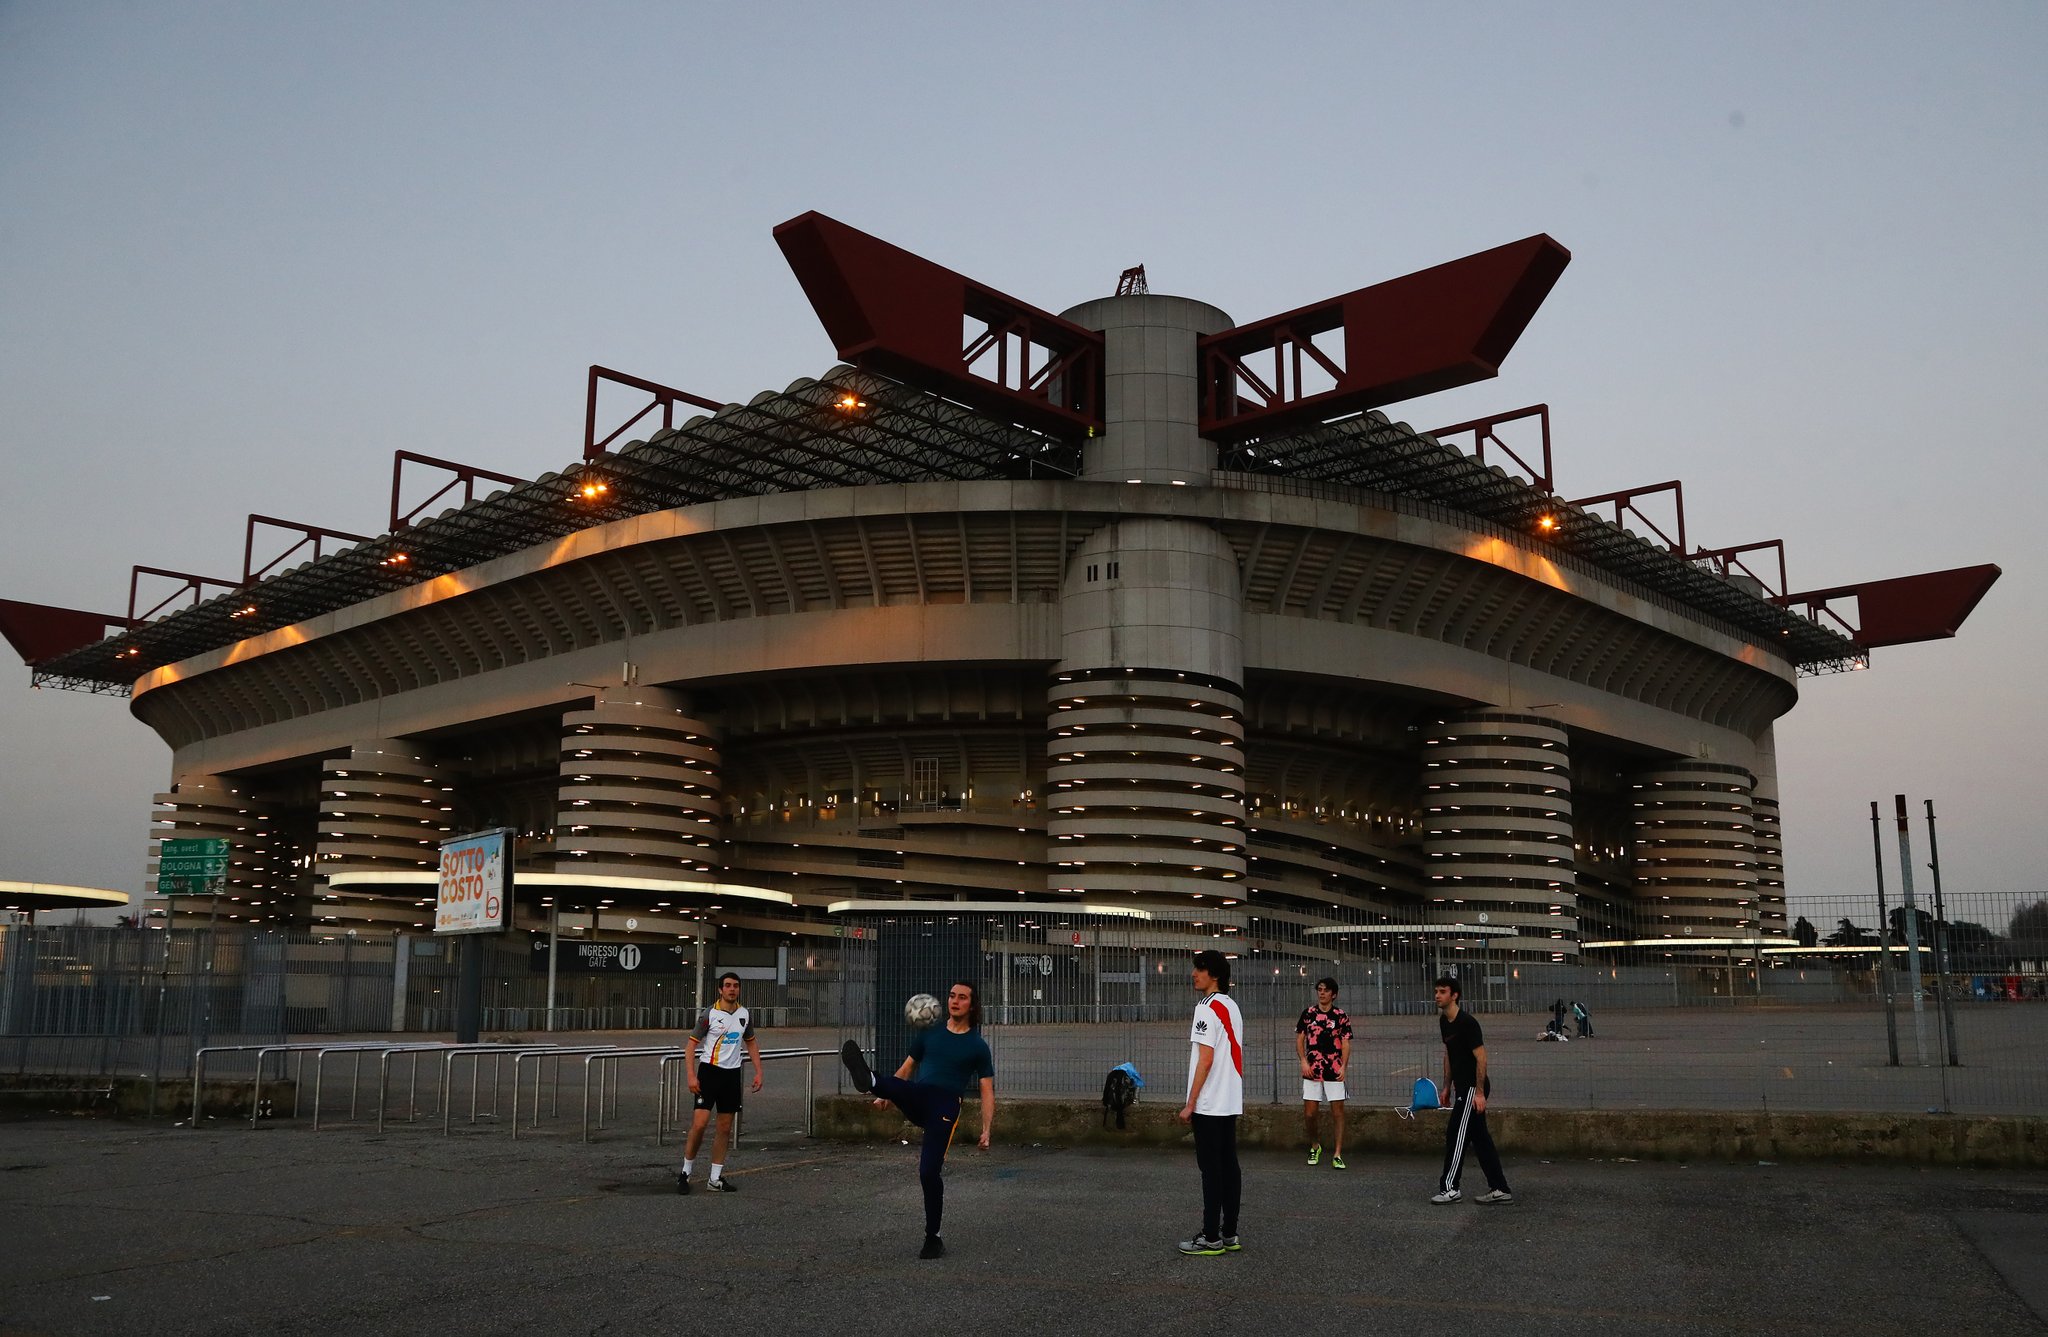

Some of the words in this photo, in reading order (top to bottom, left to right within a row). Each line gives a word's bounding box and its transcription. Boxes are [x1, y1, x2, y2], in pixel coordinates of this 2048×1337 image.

[161, 861, 202, 871] BOLOGNA
[442, 847, 485, 878] SOTTO
[440, 874, 484, 904] COSTO
[578, 944, 618, 957] INGRESSO
[622, 947, 637, 967] 11
[588, 956, 607, 968] GATE
